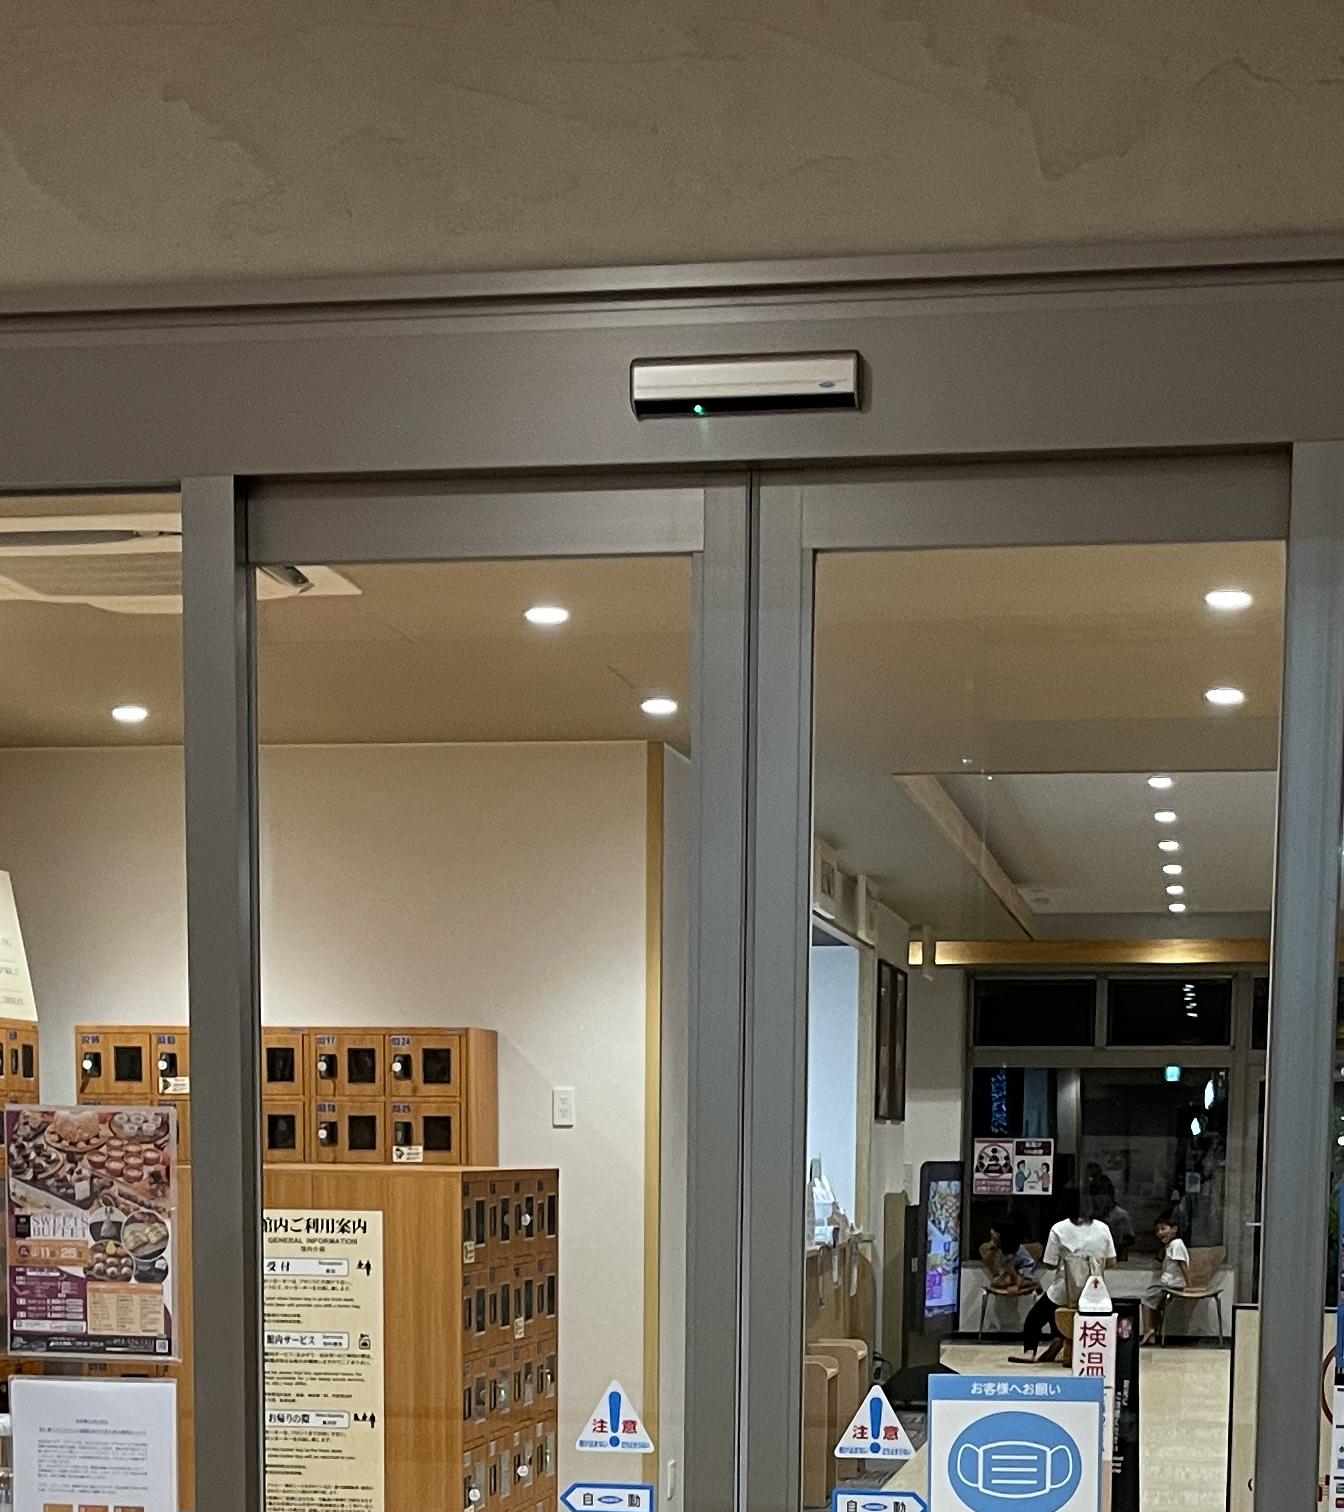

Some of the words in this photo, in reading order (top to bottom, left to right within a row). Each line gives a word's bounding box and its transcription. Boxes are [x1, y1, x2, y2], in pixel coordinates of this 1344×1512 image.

[1078, 1320, 1108, 1378] 検温
[970, 1382, 1061, 1396] お客様へお願い
